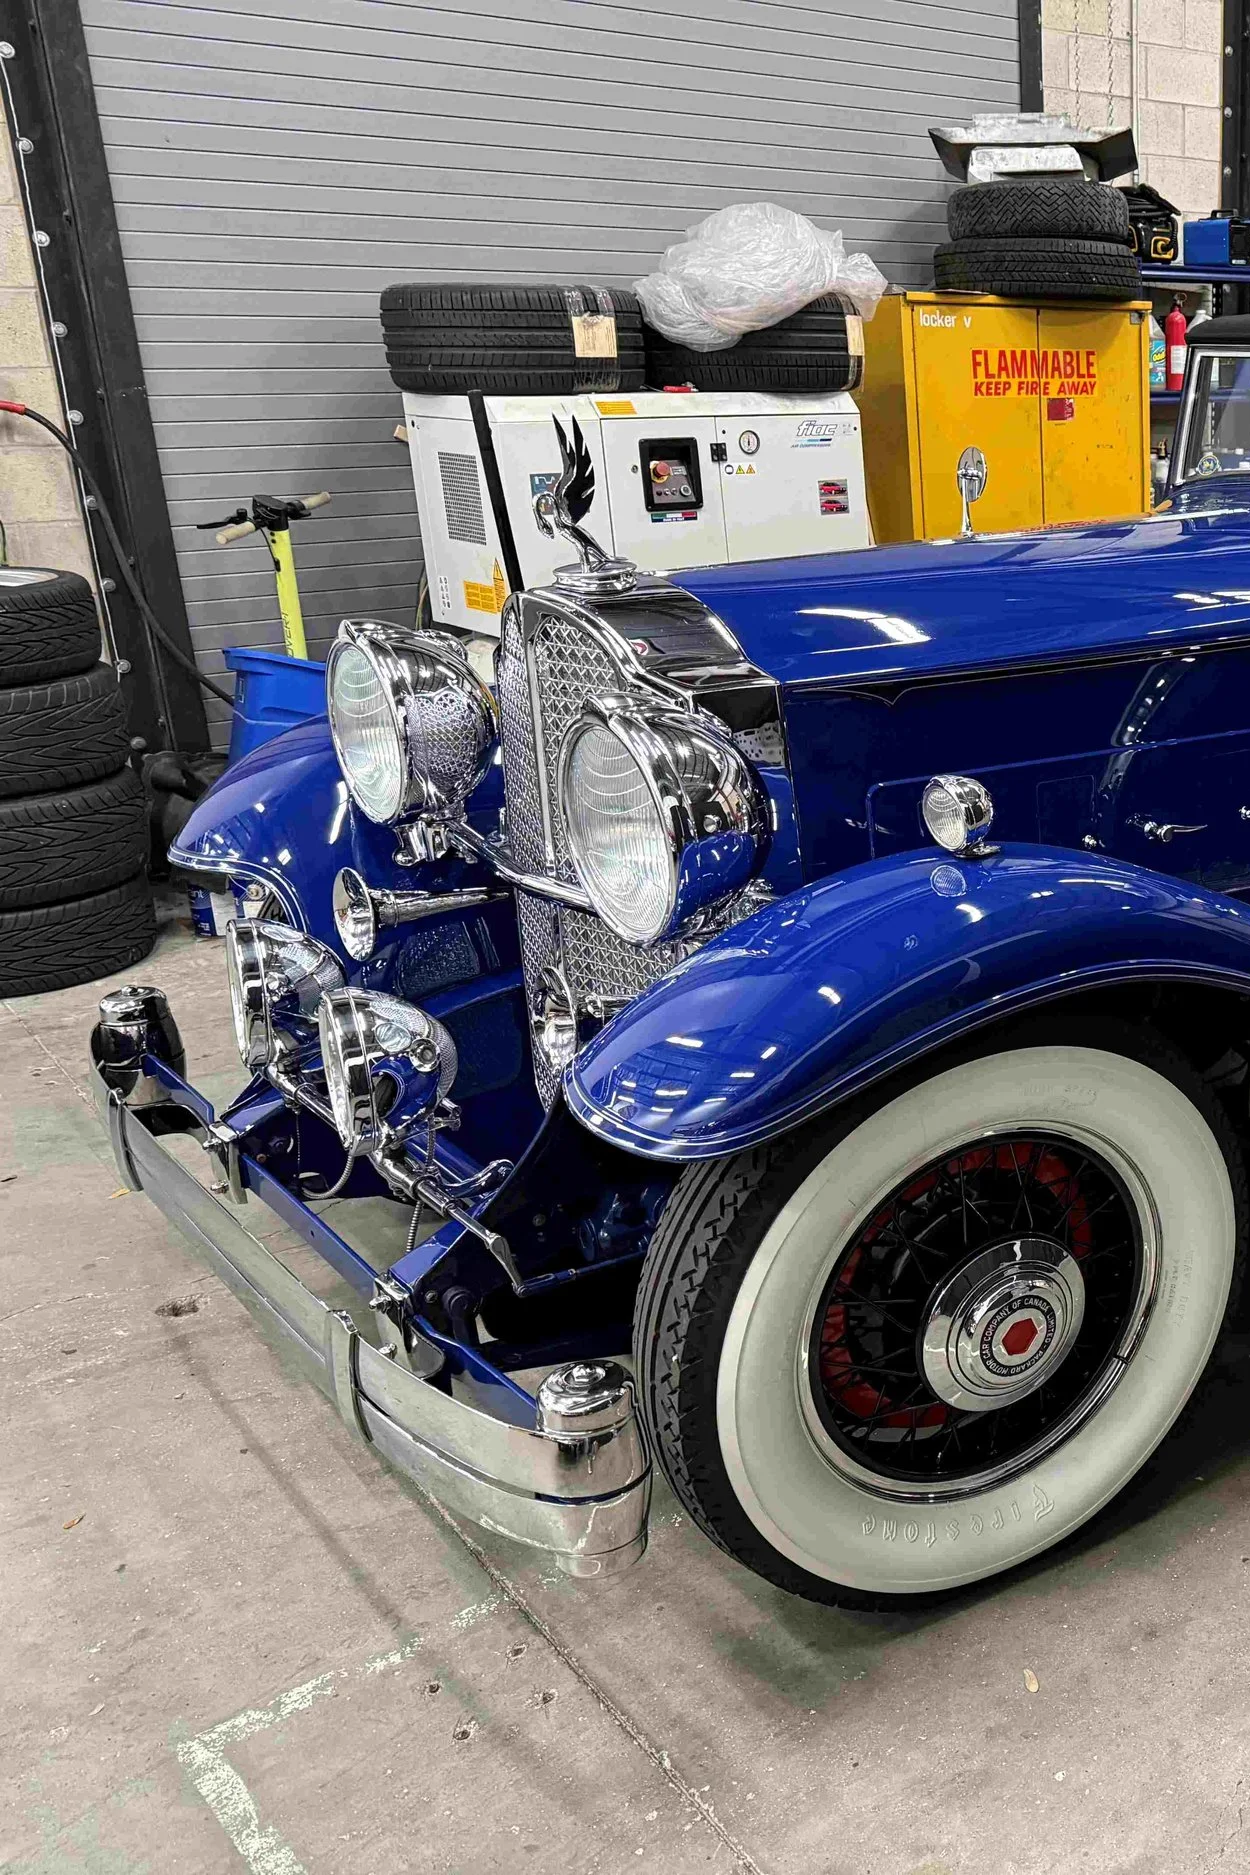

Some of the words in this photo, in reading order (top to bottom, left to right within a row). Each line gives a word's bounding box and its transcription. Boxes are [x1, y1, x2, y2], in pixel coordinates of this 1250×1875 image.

[920, 308, 957, 328] locker
[971, 349, 1097, 379] FLAMMABLE
[974, 381, 1012, 396] KEEP
[1017, 381, 1050, 396] FIRE
[1057, 381, 1097, 396] AWAY
[796, 420, 838, 437] fiac
[1012, 1300, 1022, 1310] OF
[1024, 1297, 1049, 1313] CANADA
[983, 1306, 1012, 1341] COMPANY
[1044, 1312, 1055, 1344] LIMITED
[982, 1344, 991, 1359] CAR
[986, 1358, 1008, 1375] MOTOR
[1010, 1350, 1044, 1374] PACKARD
[862, 1483, 1055, 1548] Firestone
